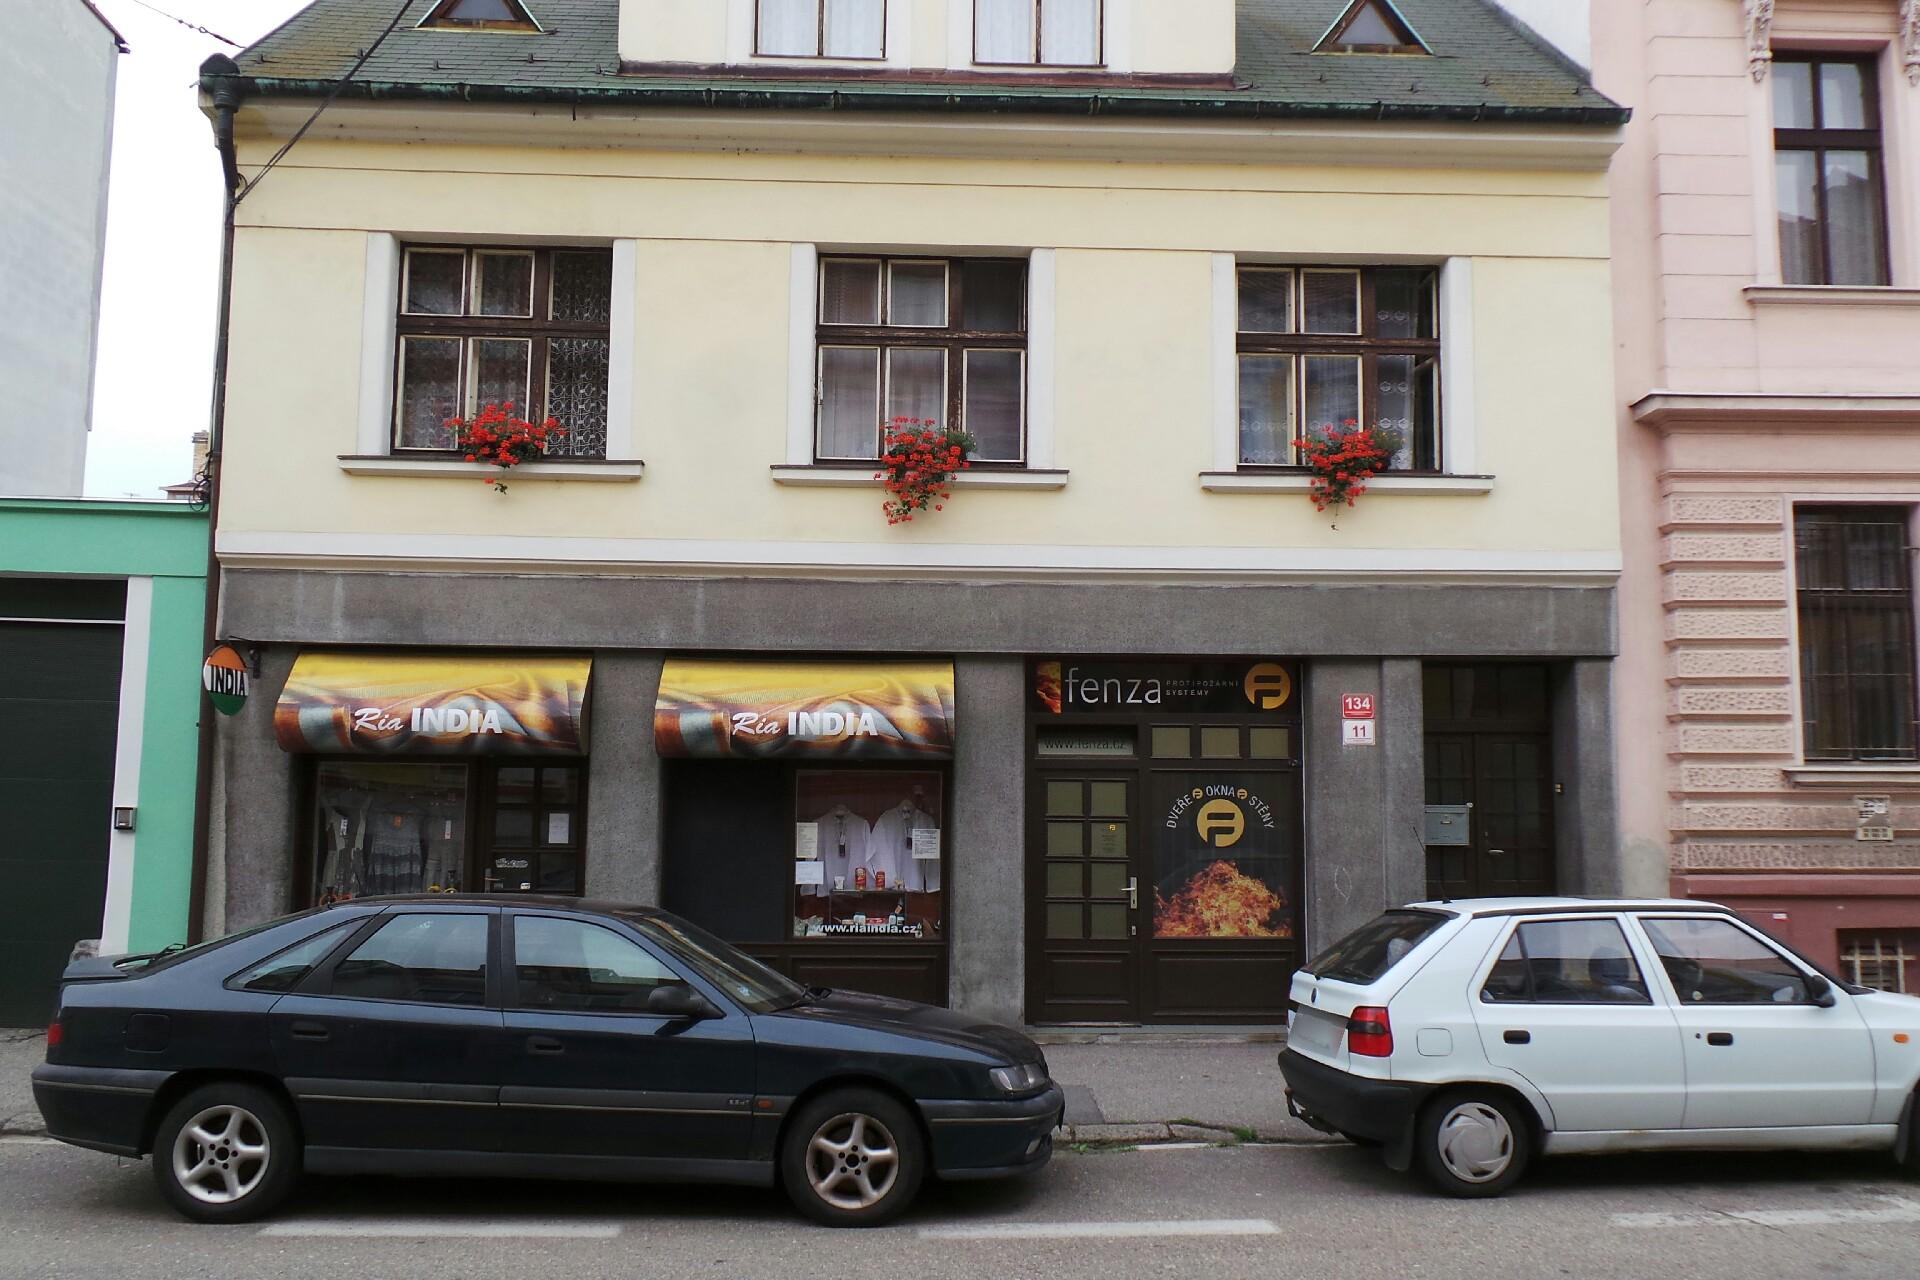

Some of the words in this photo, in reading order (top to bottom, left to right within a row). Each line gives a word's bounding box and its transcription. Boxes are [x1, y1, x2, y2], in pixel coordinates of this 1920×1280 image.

[210, 664, 246, 696] INDIA
[1065, 667, 1161, 703] fenza
[1345, 697, 1371, 710] 134
[354, 707, 403, 731] Ria
[411, 707, 503, 734] INDIA
[732, 711, 781, 736] Ria
[788, 711, 878, 736] INDIA
[1352, 725, 1367, 738] 11
[1166, 794, 1194, 829] DVEŘE
[1205, 784, 1236, 798] OKNA
[1248, 795, 1276, 829] STĚNY
[814, 919, 918, 935] www.riaindia.cz
